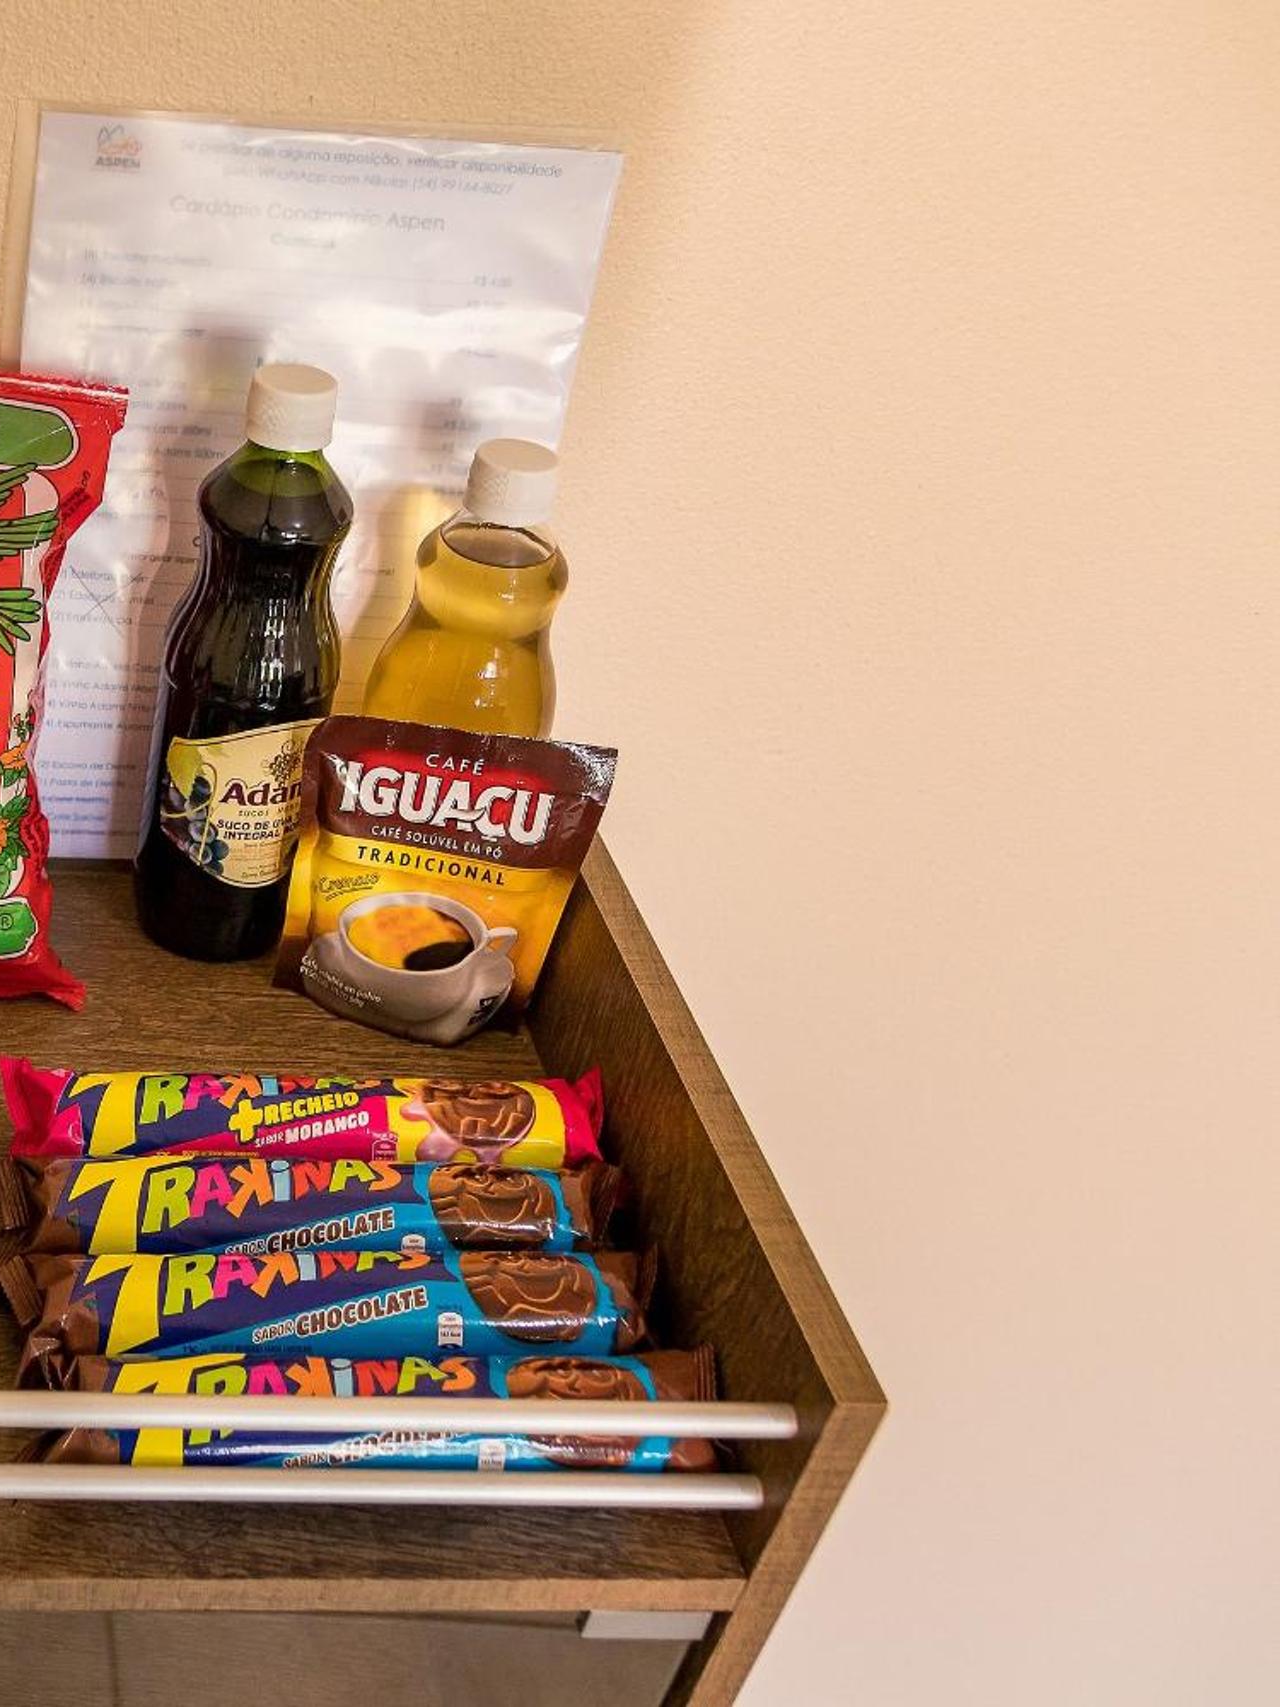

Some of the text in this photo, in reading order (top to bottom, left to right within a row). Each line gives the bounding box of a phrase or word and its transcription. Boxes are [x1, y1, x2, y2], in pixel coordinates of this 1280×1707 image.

[95, 156, 141, 168] ASPEN
[462, 157, 563, 179] disponibilidade
[170, 193, 259, 221] Cardápio
[386, 211, 447, 234] Aspen
[426, 753, 486, 776] CAFÉ
[339, 760, 556, 846] IGUAÇU
[217, 819, 251, 831] SUCO
[254, 821, 271, 831] DE
[223, 829, 280, 841] INTEGRAL
[371, 825, 503, 859] CAFÉ SOLÚVEL EM PÓ
[357, 846, 505, 886] TRADICIONAL
[255, 1111, 370, 1148] SABOR MORANGO
[267, 1206, 396, 1253] CHOCOLATE
[252, 1323, 295, 1344] SABOR
[294, 1285, 428, 1338] CHOCOLATE
